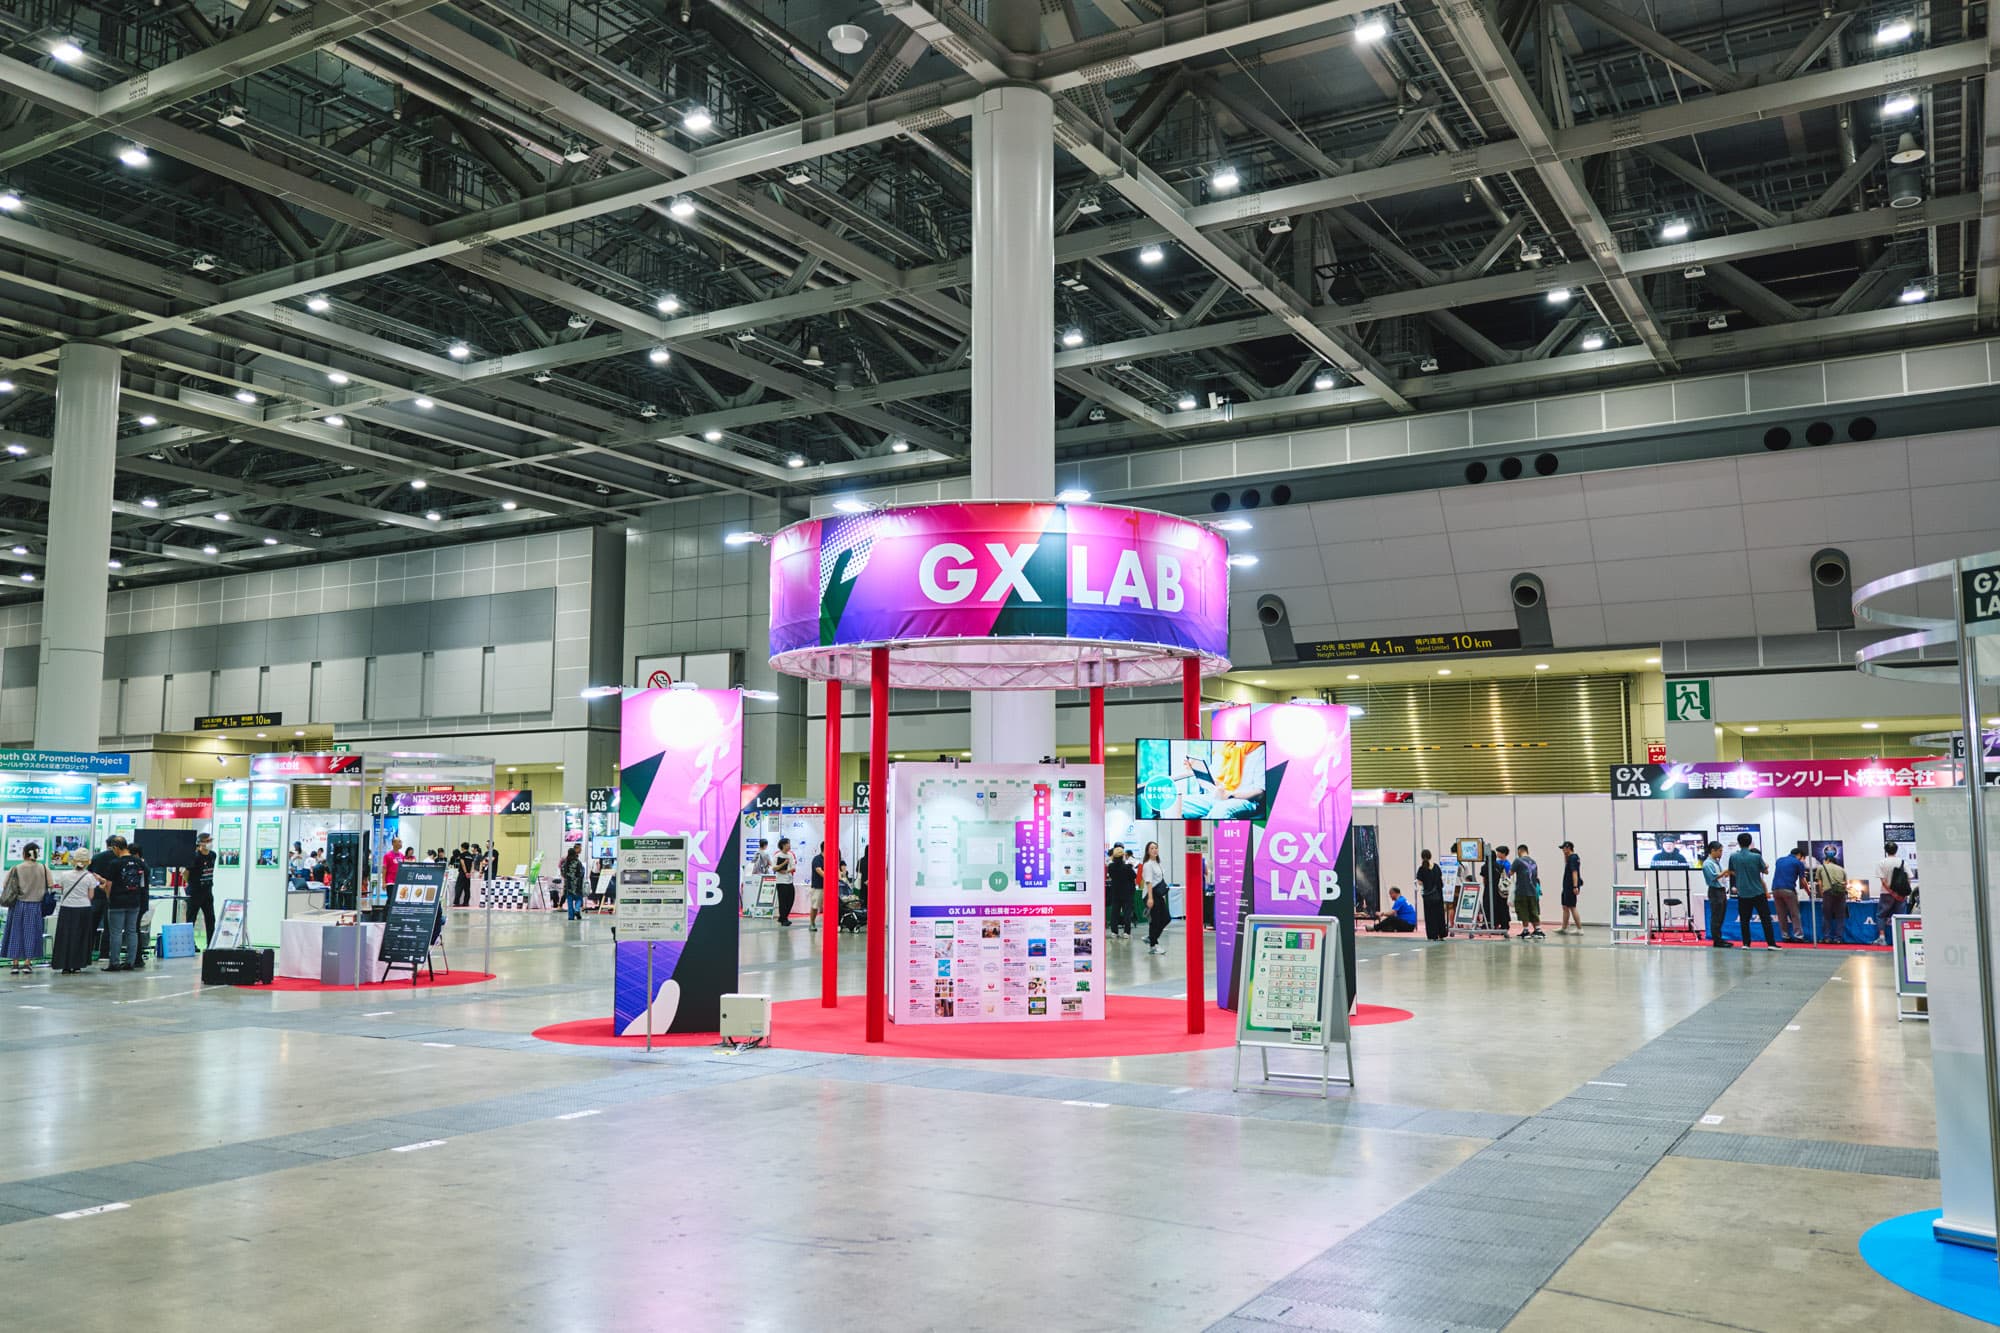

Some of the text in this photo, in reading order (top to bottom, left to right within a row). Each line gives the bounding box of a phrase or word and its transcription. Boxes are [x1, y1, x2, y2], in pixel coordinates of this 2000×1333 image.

[918, 543, 1186, 614] GX LAB
[22, 752, 37, 761] GX
[39, 754, 88, 764] Promotion
[90, 755, 123, 767] Project
[1616, 767, 1645, 781] GX
[590, 790, 605, 801] GX
[1617, 783, 1652, 797] LAB
[511, 802, 530, 812] L-03
[590, 801, 607, 812] LAB
[756, 798, 779, 808] L-04
[1268, 831, 1329, 864] GX
[1270, 869, 1341, 901] LAB
[948, 908, 976, 916] GX LAB
